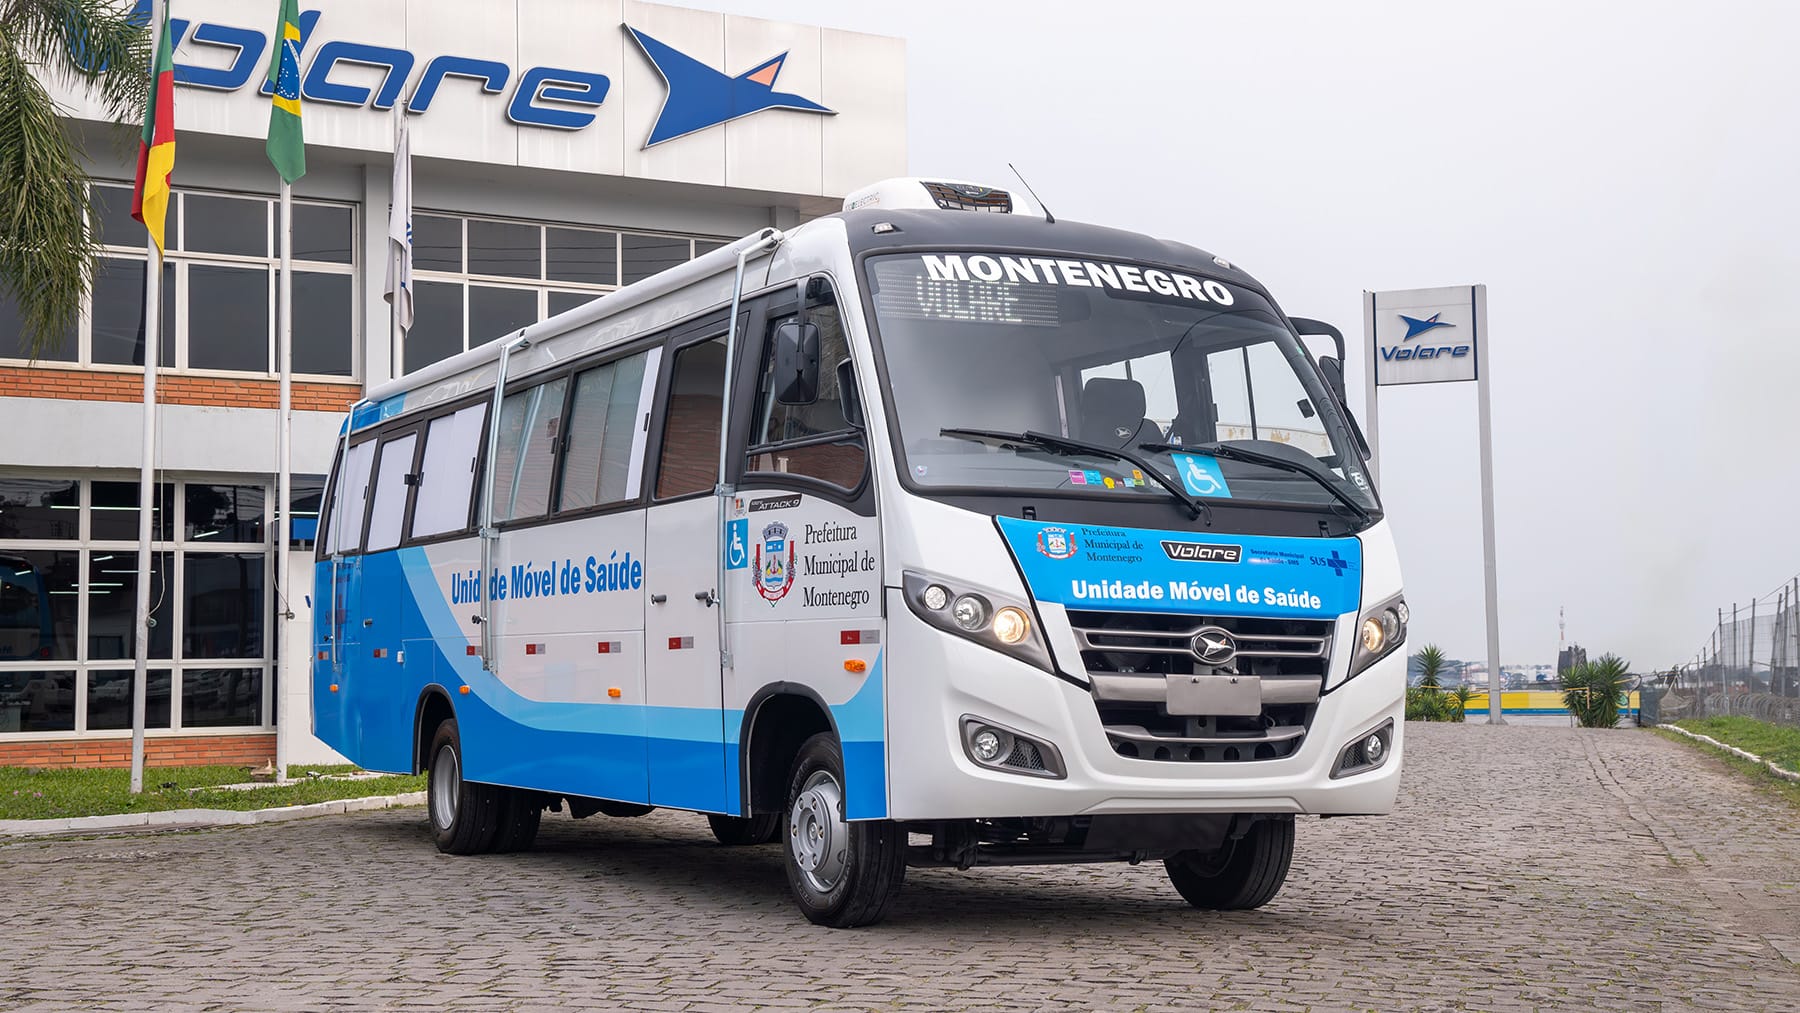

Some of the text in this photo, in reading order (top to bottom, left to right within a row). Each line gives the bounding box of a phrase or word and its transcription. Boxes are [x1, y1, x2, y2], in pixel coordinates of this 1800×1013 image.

[921, 255, 1235, 306] MONTENEGRO
[1381, 345, 1470, 361] Volare
[759, 500, 792, 510] ATTACK
[804, 521, 857, 544] Prefeitura
[1081, 527, 1126, 537] Prefeitura
[1084, 538, 1144, 550] Municipal de
[1168, 543, 1237, 560] Volare
[803, 550, 875, 578] Municipal de
[1086, 552, 1143, 564] Montenegro
[1309, 555, 1327, 567] SUS
[451, 550, 642, 605] Unidde Móvel de Saúde
[803, 586, 870, 610] Montenegro
[1071, 579, 1322, 609] Unidade Móvel de Saúde
